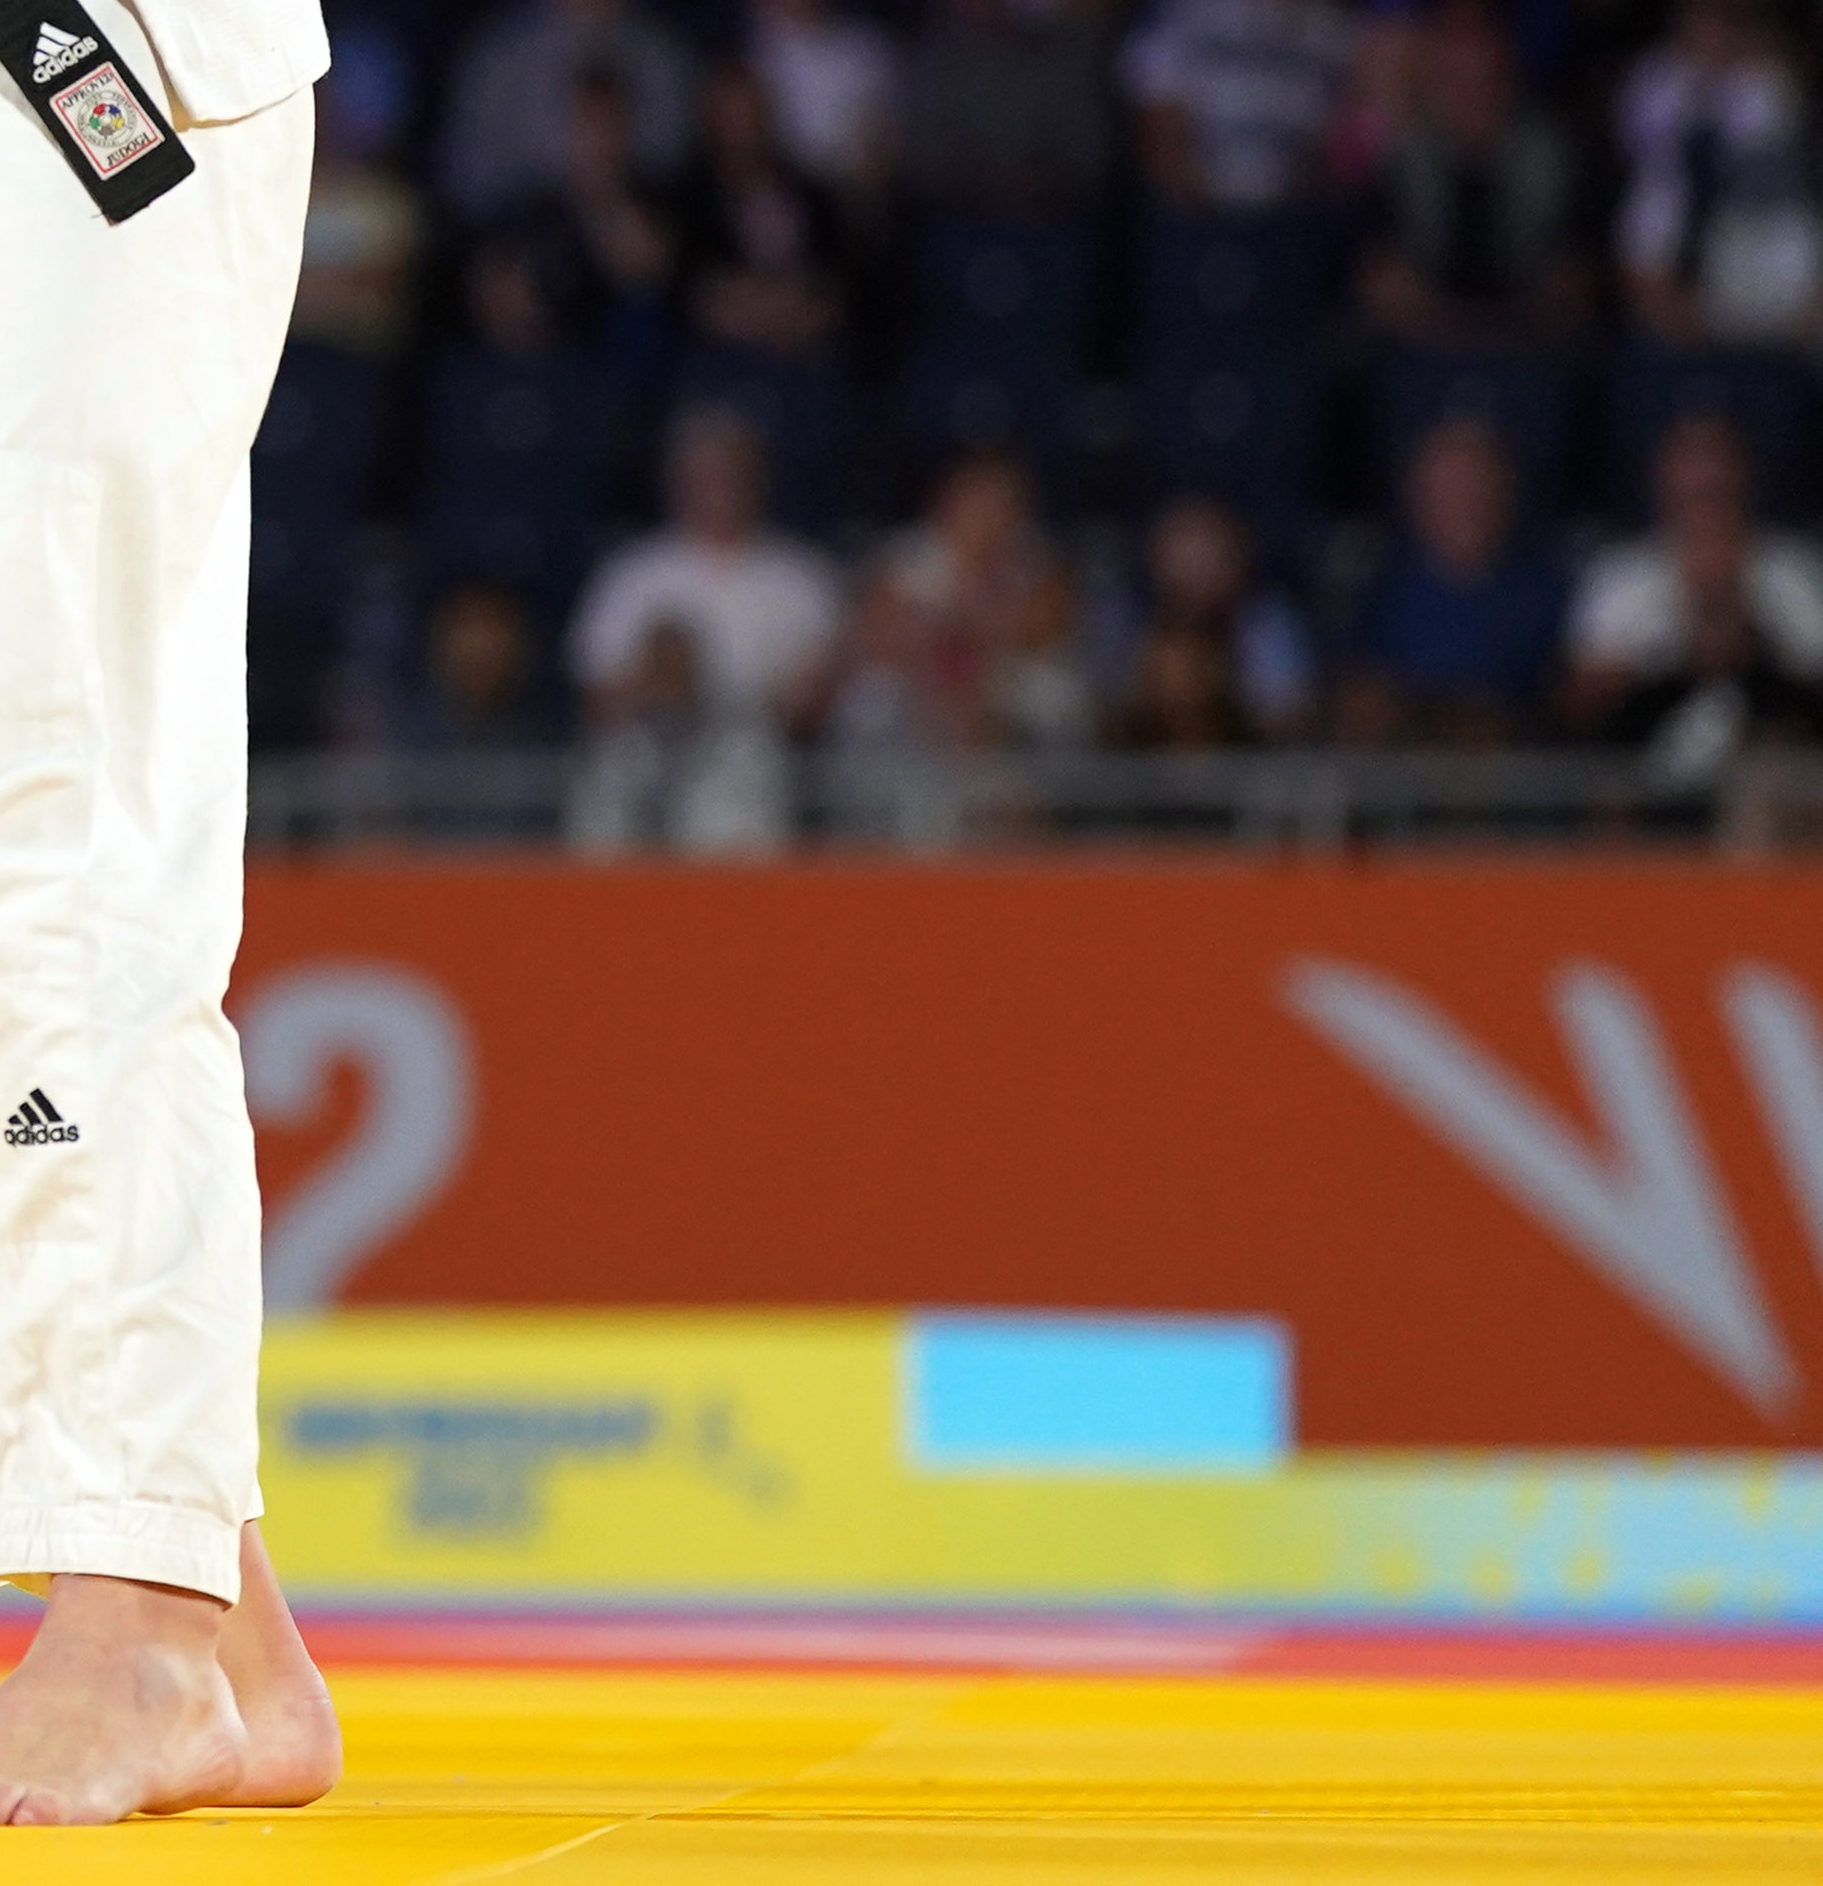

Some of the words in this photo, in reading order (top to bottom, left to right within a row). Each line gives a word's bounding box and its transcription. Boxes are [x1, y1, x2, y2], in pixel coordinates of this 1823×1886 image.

[33, 36, 98, 84] adidas
[62, 71, 115, 108] APPROVED
[107, 132, 151, 166] JUDOGI
[4, 1125, 80, 1147] adidas
